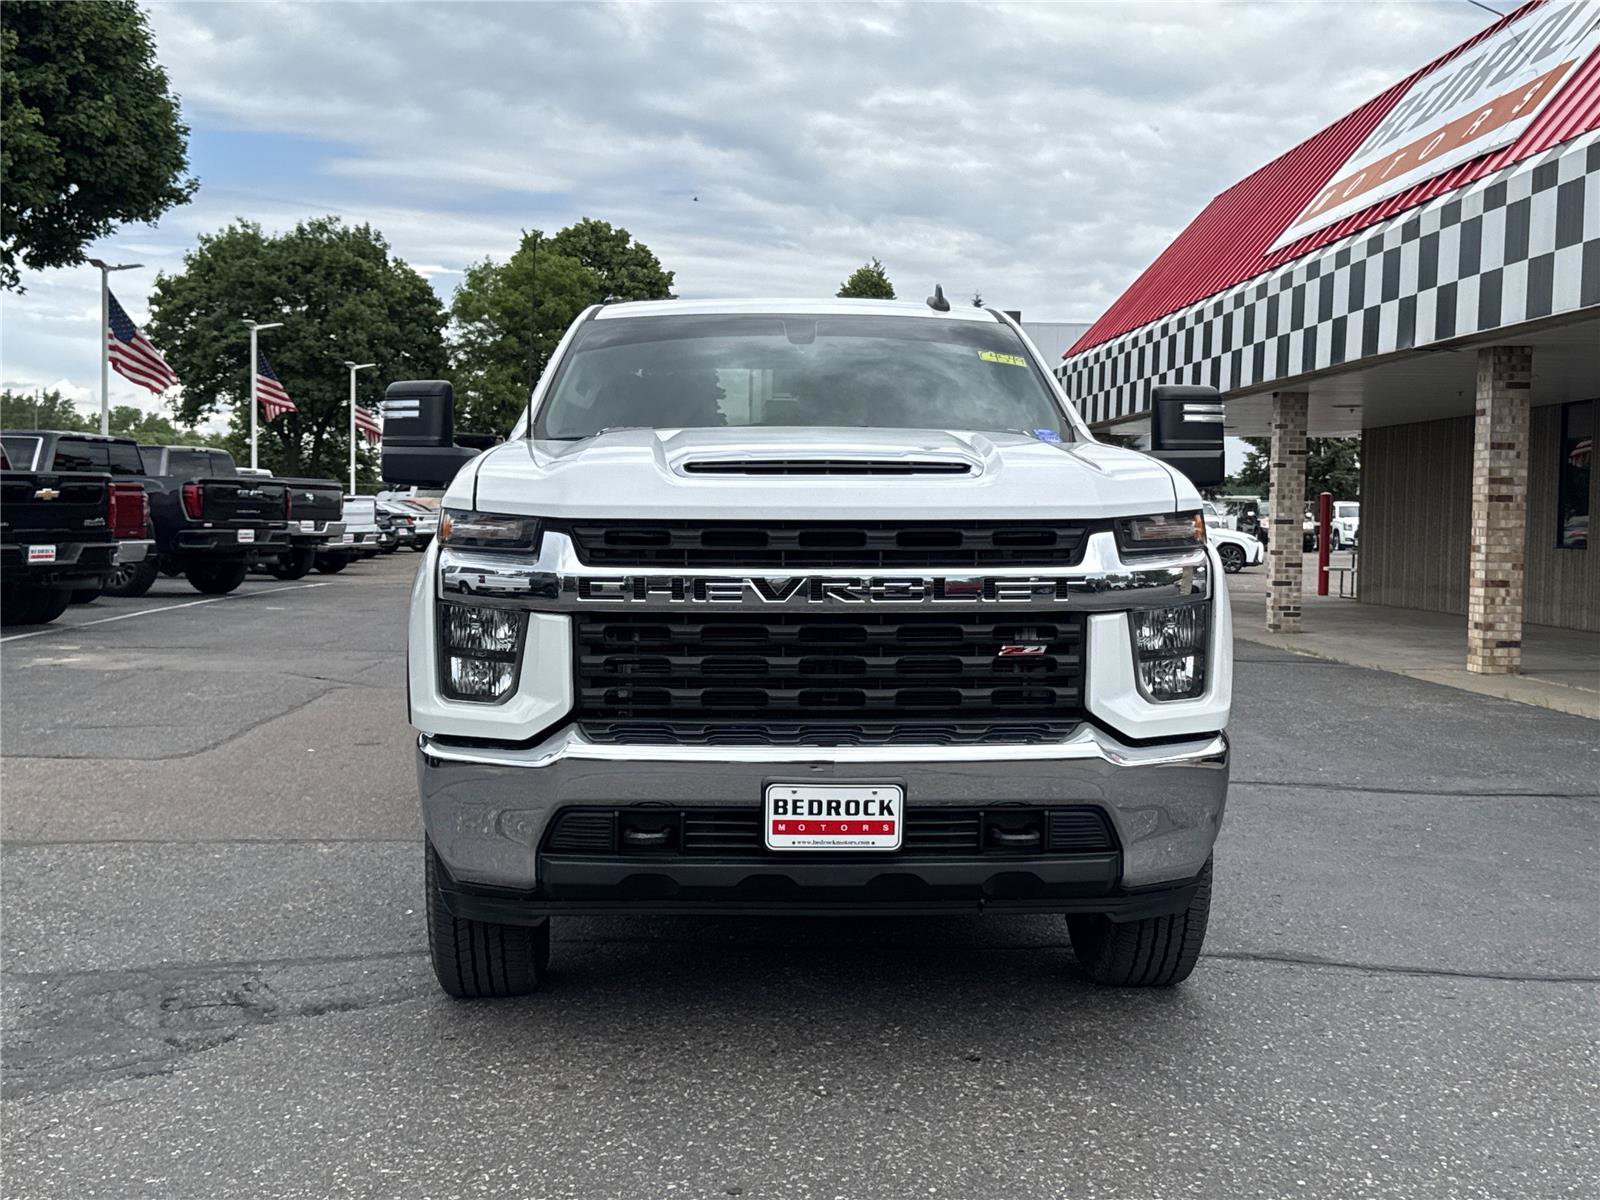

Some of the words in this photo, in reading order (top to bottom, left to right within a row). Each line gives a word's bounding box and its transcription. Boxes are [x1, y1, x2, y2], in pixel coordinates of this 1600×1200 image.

[1311, 80, 1544, 215] MOTORS
[576, 576, 1088, 603] CHEVROLET
[773, 799, 895, 816] BEDROCK
[778, 824, 889, 832] MOTORS
